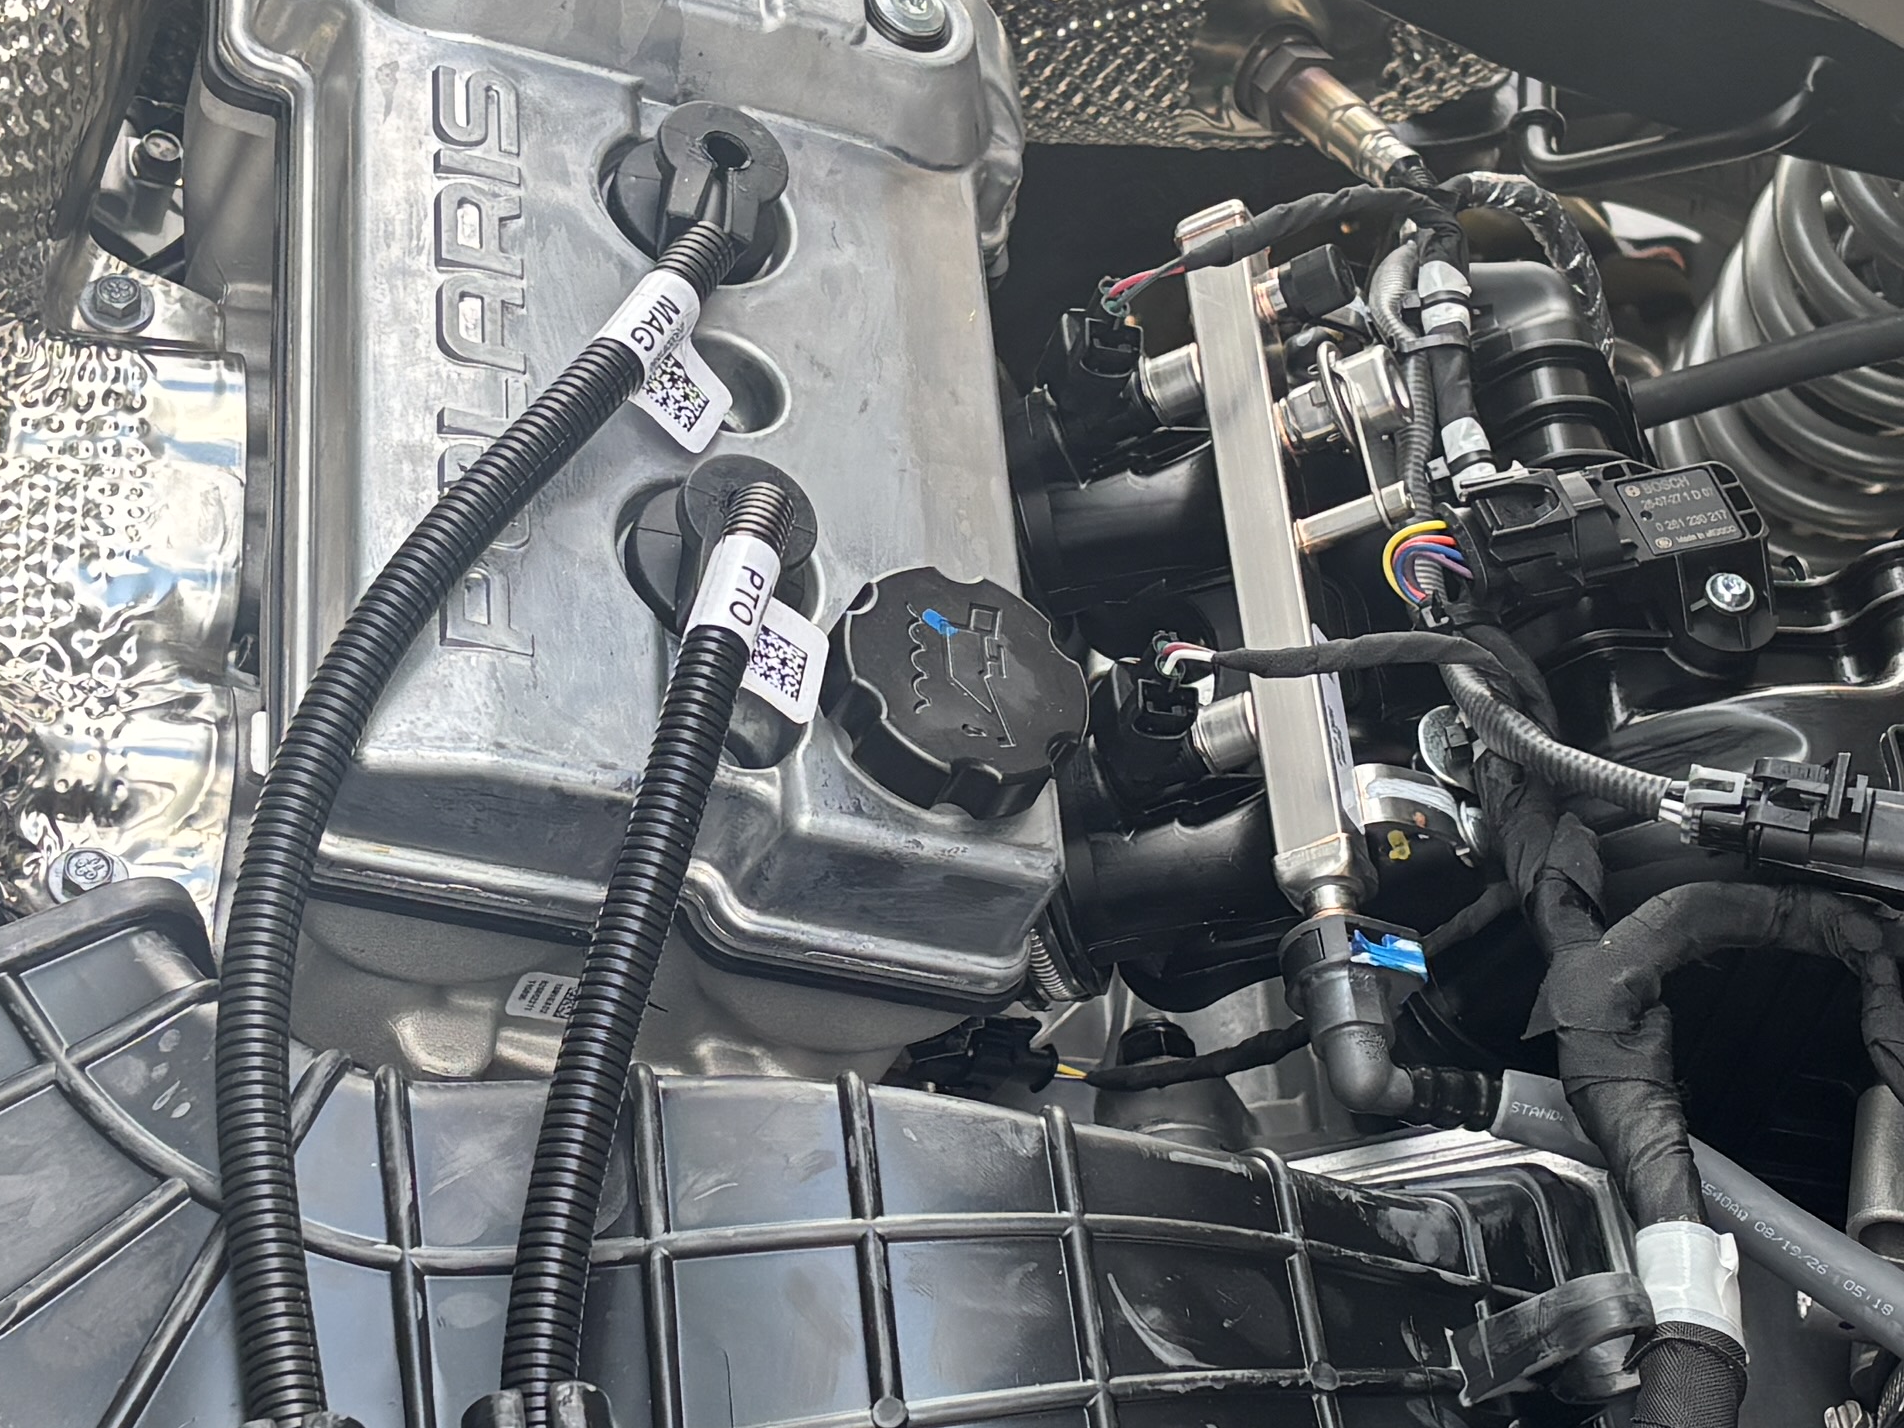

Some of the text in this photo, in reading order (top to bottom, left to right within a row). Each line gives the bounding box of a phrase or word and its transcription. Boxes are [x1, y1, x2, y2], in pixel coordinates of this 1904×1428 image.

[630, 294, 681, 352] MAG
[1641, 475, 1691, 495] BOSCH
[729, 565, 765, 626] PTO
[1511, 1100, 1564, 1122] STAND
[1754, 1220, 1830, 1275] 08/19/26
